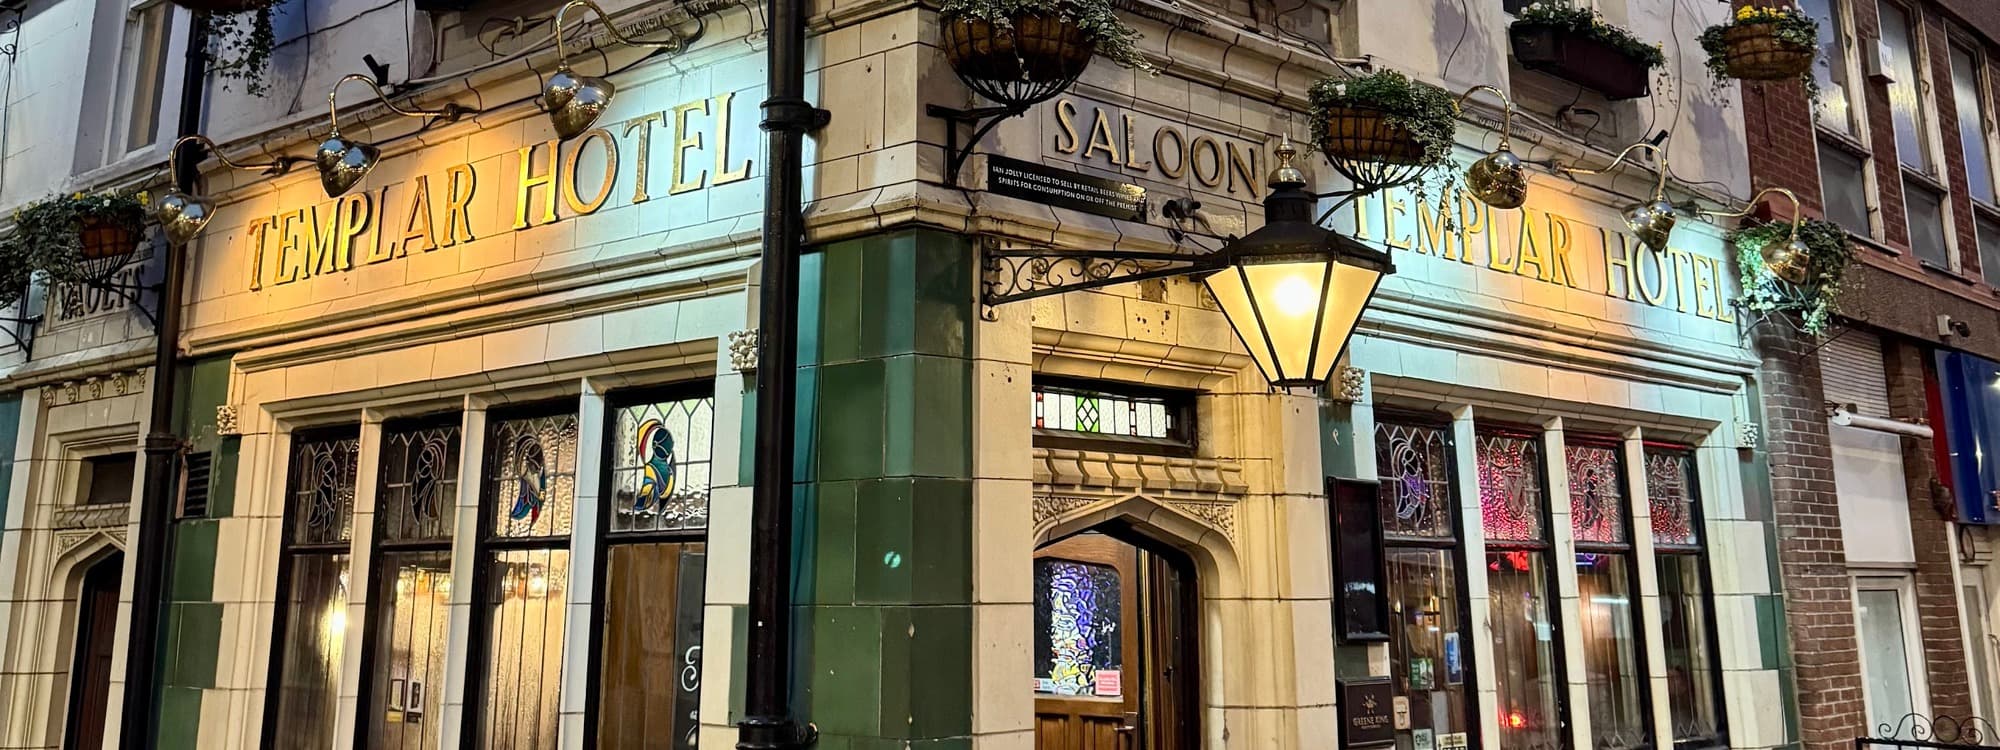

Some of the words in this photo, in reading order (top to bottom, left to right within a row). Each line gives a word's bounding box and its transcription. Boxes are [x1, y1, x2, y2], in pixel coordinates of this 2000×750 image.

[1005, 169, 1022, 178] JOLLY
[1024, 172, 1051, 184] LICENSED
[1052, 177, 1060, 185] TO
[1060, 180, 1072, 189] SELL
[1100, 188, 1114, 198] BEERS
[1055, 99, 1259, 199] SALOON
[248, 163, 476, 291] TEMPLAR
[512, 92, 752, 231] HOTEL
[998, 176, 1020, 187] SPIRITS
[1020, 180, 1032, 190] FOR
[1032, 184, 1075, 198] CONSUMPTION
[1076, 192, 1085, 200] ON
[1105, 199, 1116, 208] THE
[1346, 160, 1577, 288] TEMPLAR
[1600, 227, 1734, 324] HOTEL
[58, 264, 146, 321] VAULTS
